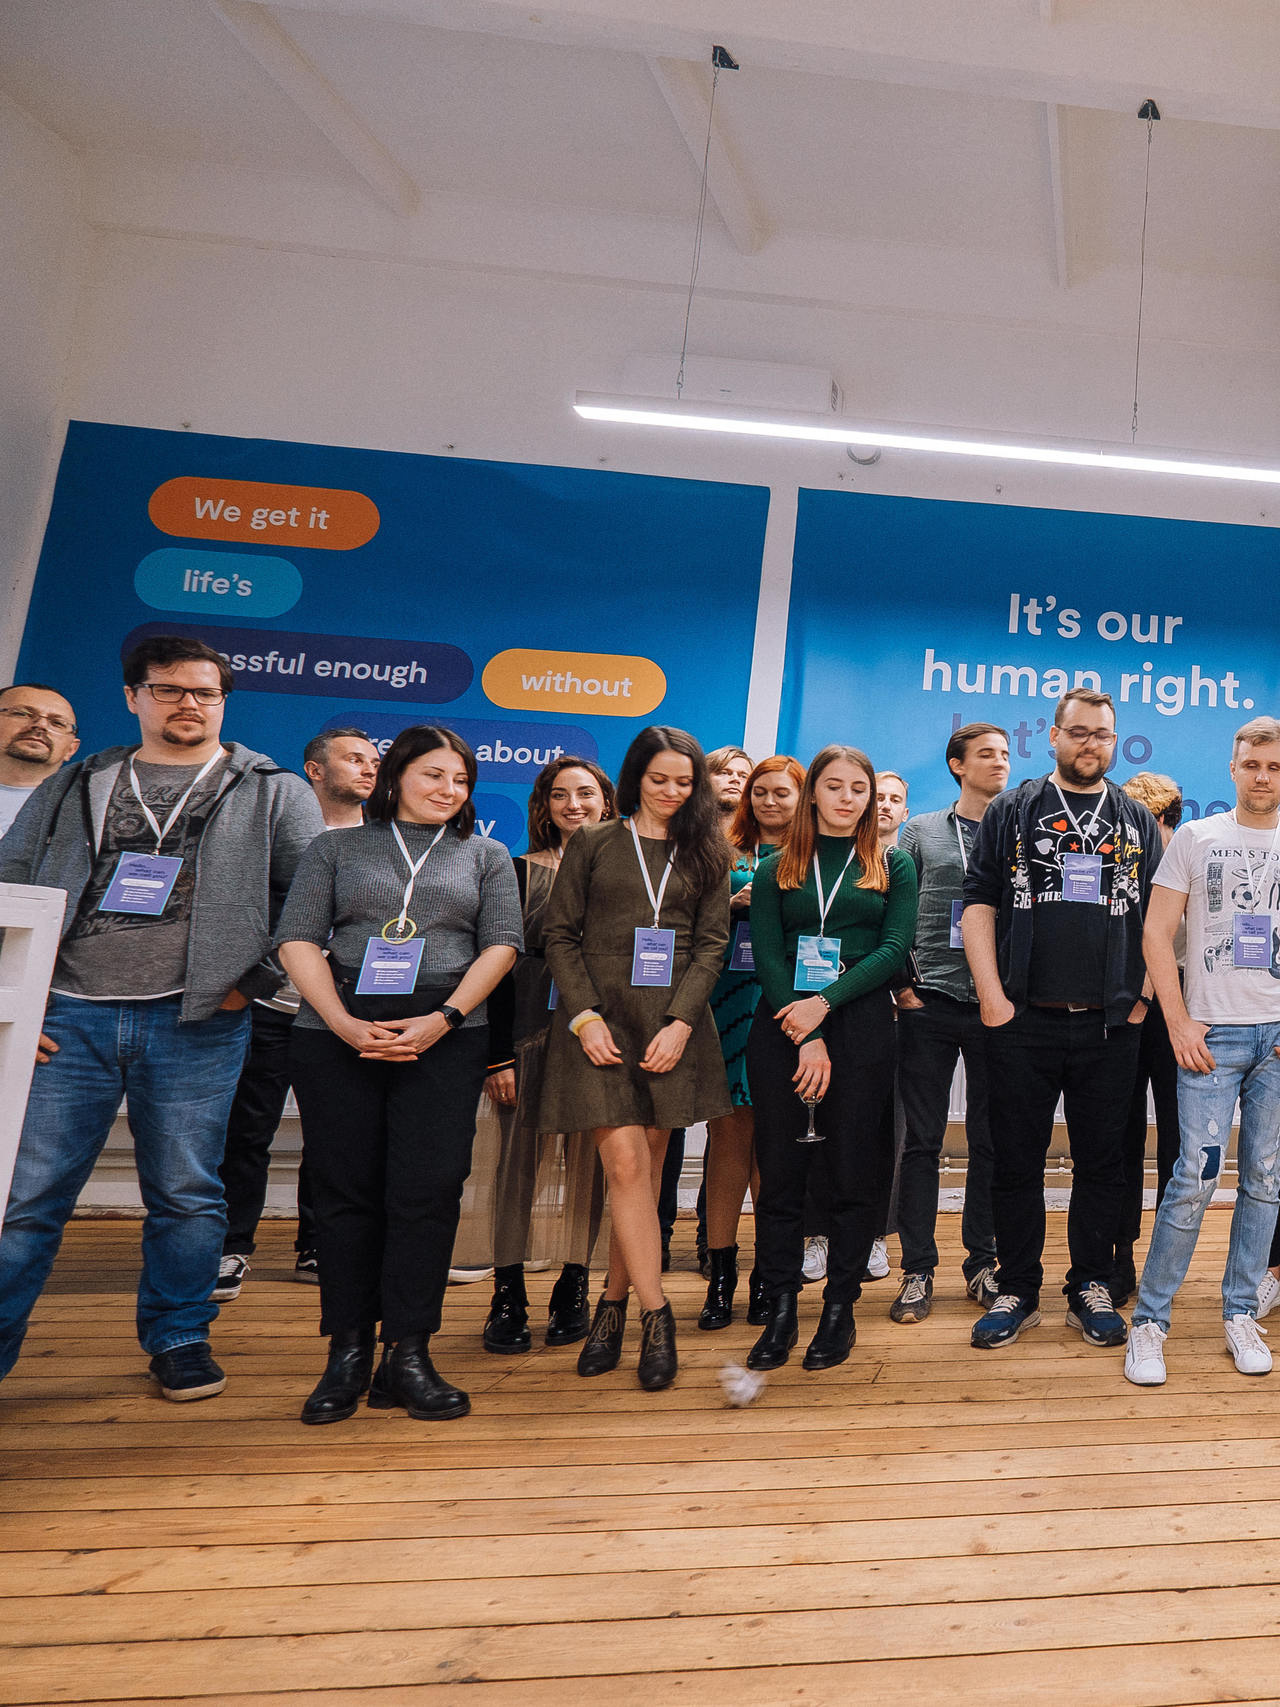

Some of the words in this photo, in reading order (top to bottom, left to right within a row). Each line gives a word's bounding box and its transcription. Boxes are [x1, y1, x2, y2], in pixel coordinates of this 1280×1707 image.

[194, 497, 241, 522] We
[250, 507, 300, 530] get
[308, 507, 330, 530] it
[183, 569, 253, 596] life's
[1008, 593, 1081, 639] It's
[1097, 611, 1183, 644] our
[314, 660, 428, 688] enough
[521, 671, 633, 698] without
[922, 648, 1101, 698] human
[1120, 661, 1255, 716] right.
[476, 740, 565, 765] about
